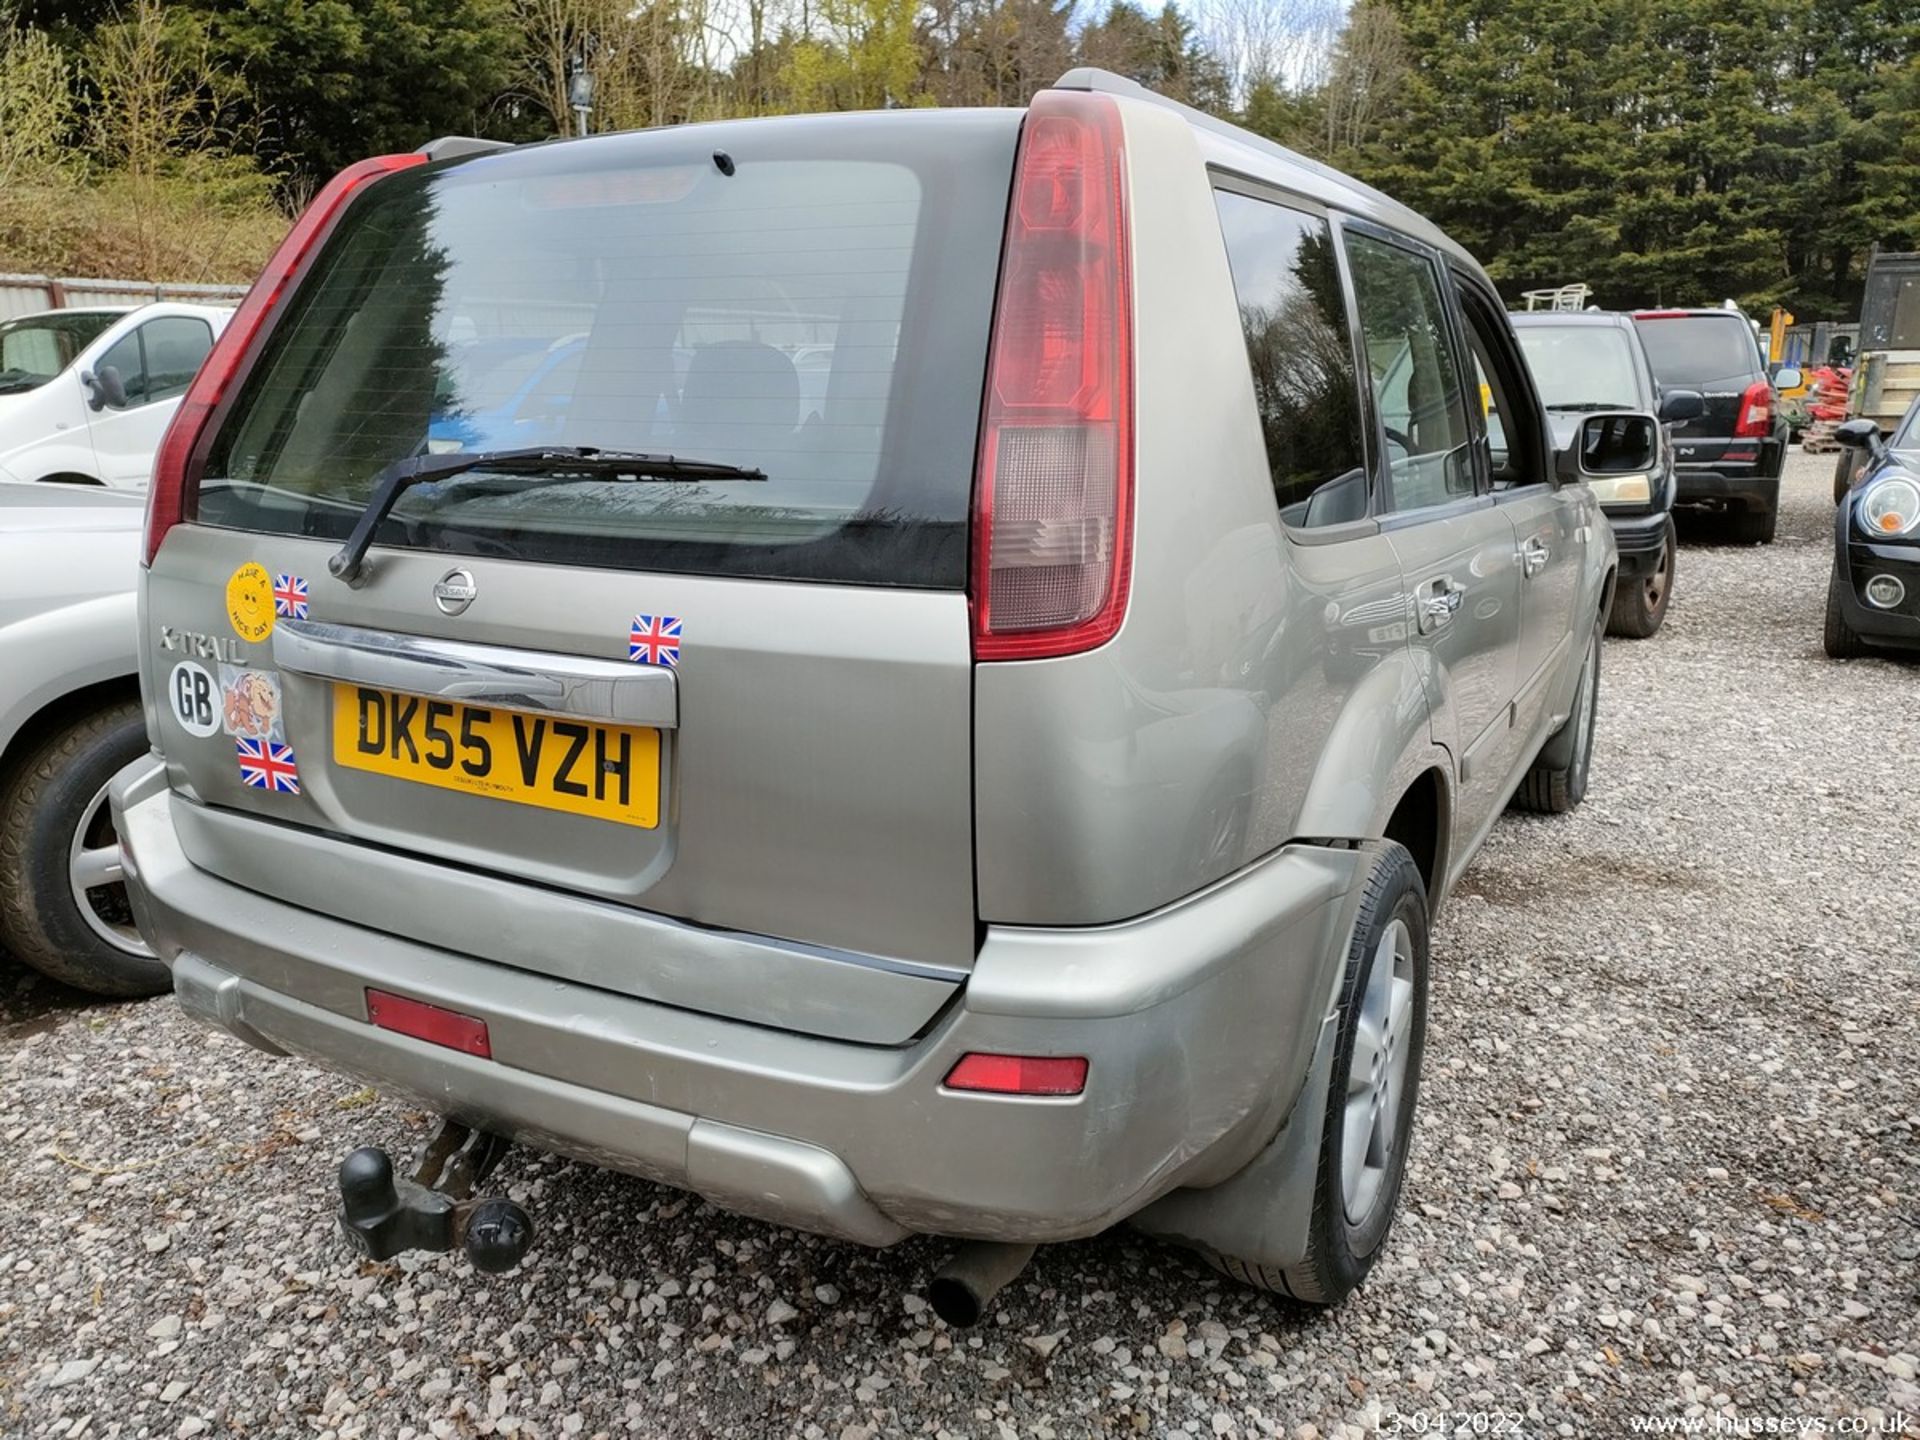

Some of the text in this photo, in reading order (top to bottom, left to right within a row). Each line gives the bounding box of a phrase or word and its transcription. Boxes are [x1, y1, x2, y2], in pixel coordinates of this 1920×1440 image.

[238, 568, 259, 580] HAVE
[232, 611, 268, 636] NICE DAY
[160, 625, 247, 666] X-TRAIL
[176, 667, 213, 727] GB
[357, 686, 631, 806] DK55 VZH
